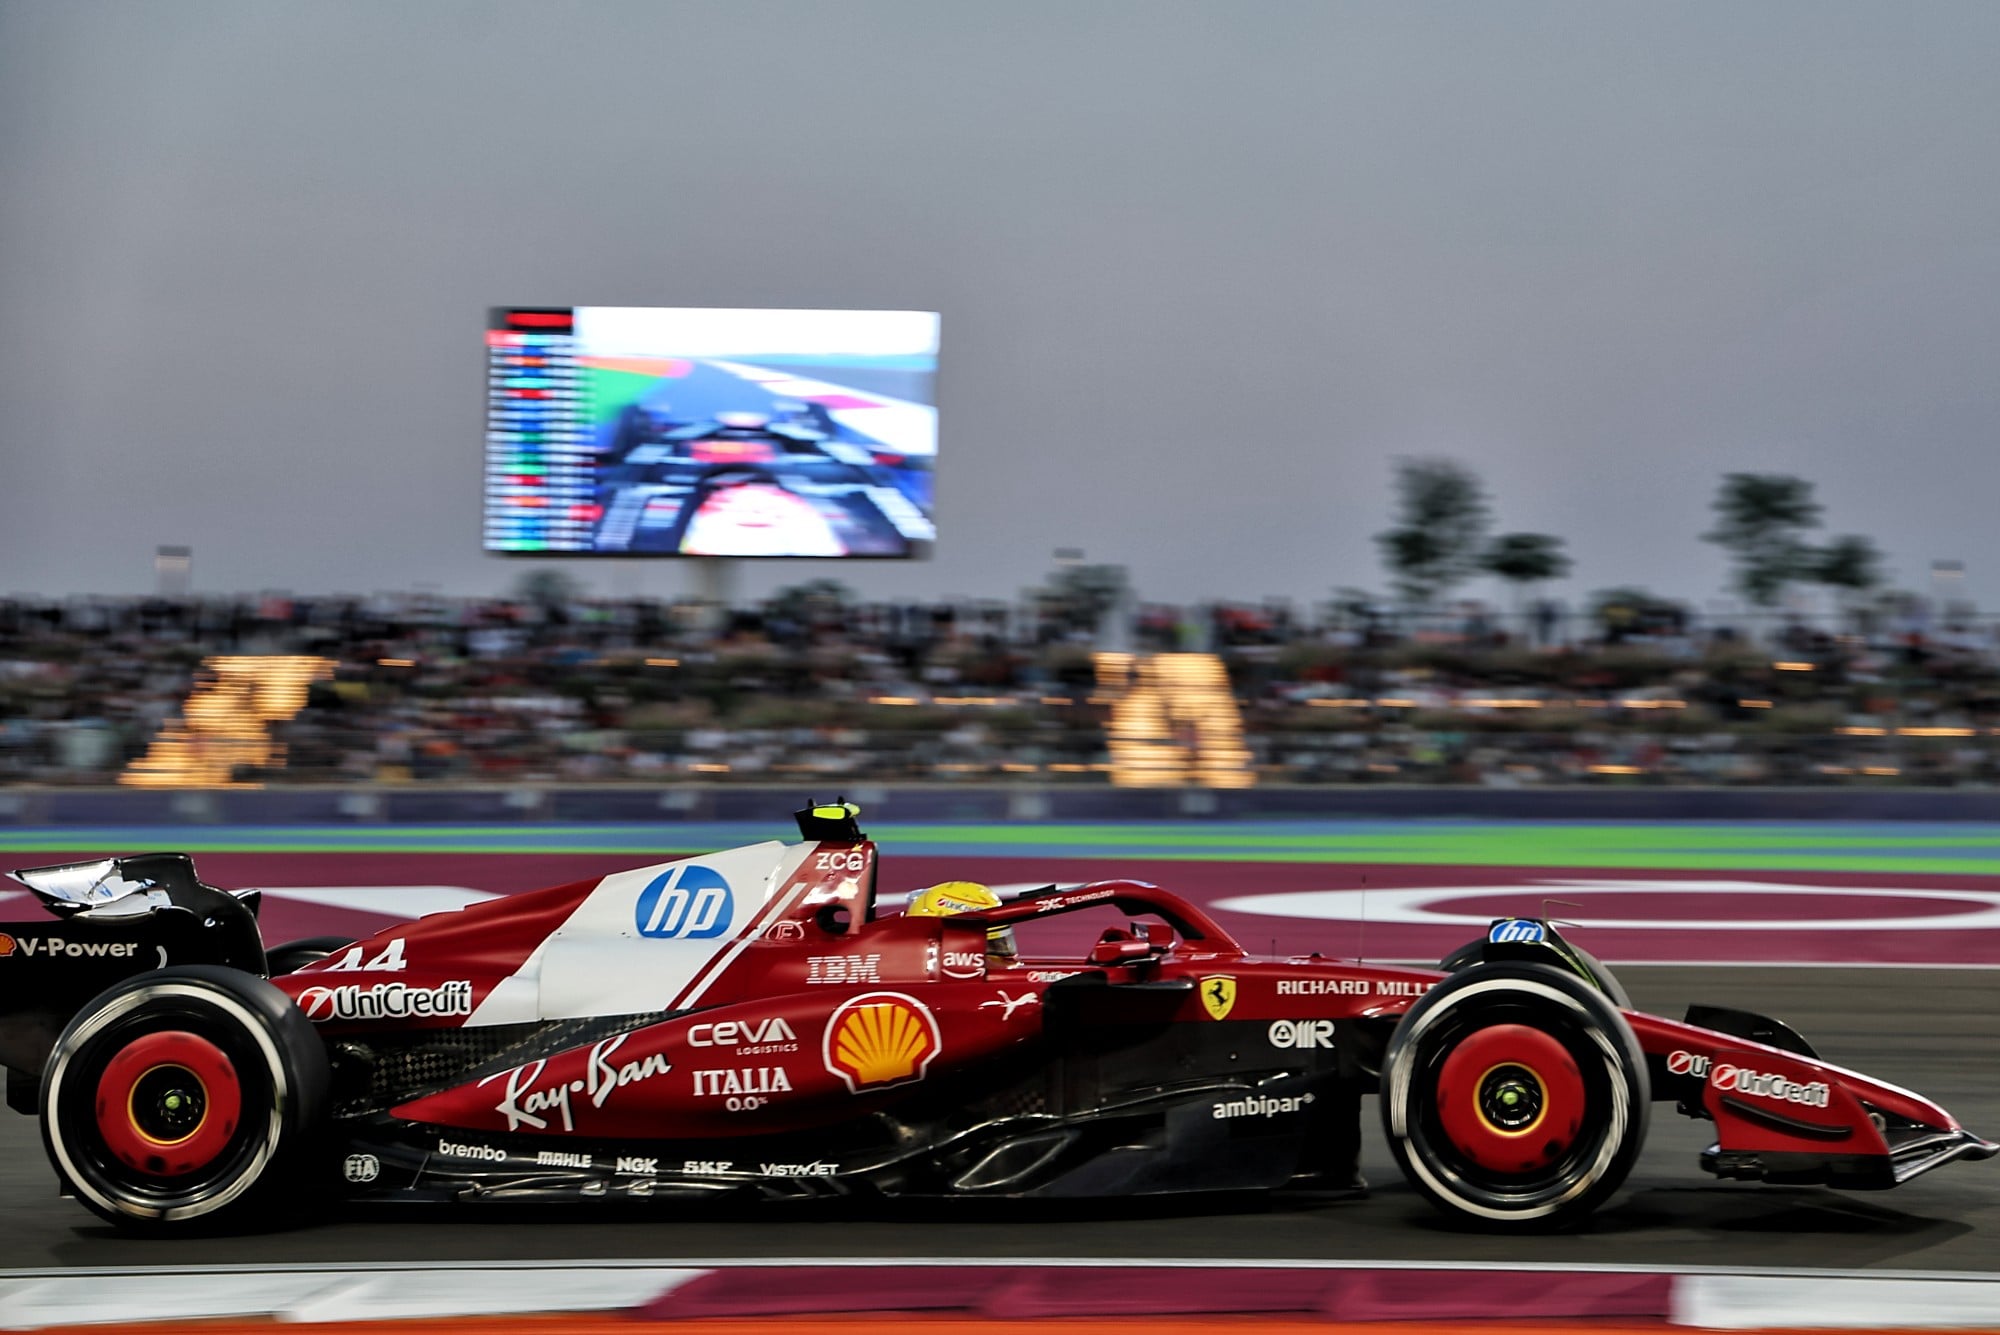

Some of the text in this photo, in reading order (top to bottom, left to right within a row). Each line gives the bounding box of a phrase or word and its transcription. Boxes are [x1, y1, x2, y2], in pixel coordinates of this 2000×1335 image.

[643, 866, 727, 938] hp
[17, 938, 138, 957] V-Power
[322, 938, 407, 972] 44
[806, 954, 880, 984] IBM
[942, 952, 985, 967] aws
[1277, 980, 1370, 995] RICHARD
[336, 981, 473, 1019] UniCredit
[736, 1043, 799, 1055] LOGISTICS
[692, 1067, 793, 1096] ITALIA
[1736, 1068, 1830, 1107] UniCredit
[438, 1139, 507, 1162] brembo
[536, 1151, 592, 1168] MAHLE
[615, 1157, 658, 1174] NGK
[682, 1161, 733, 1175] SKF
